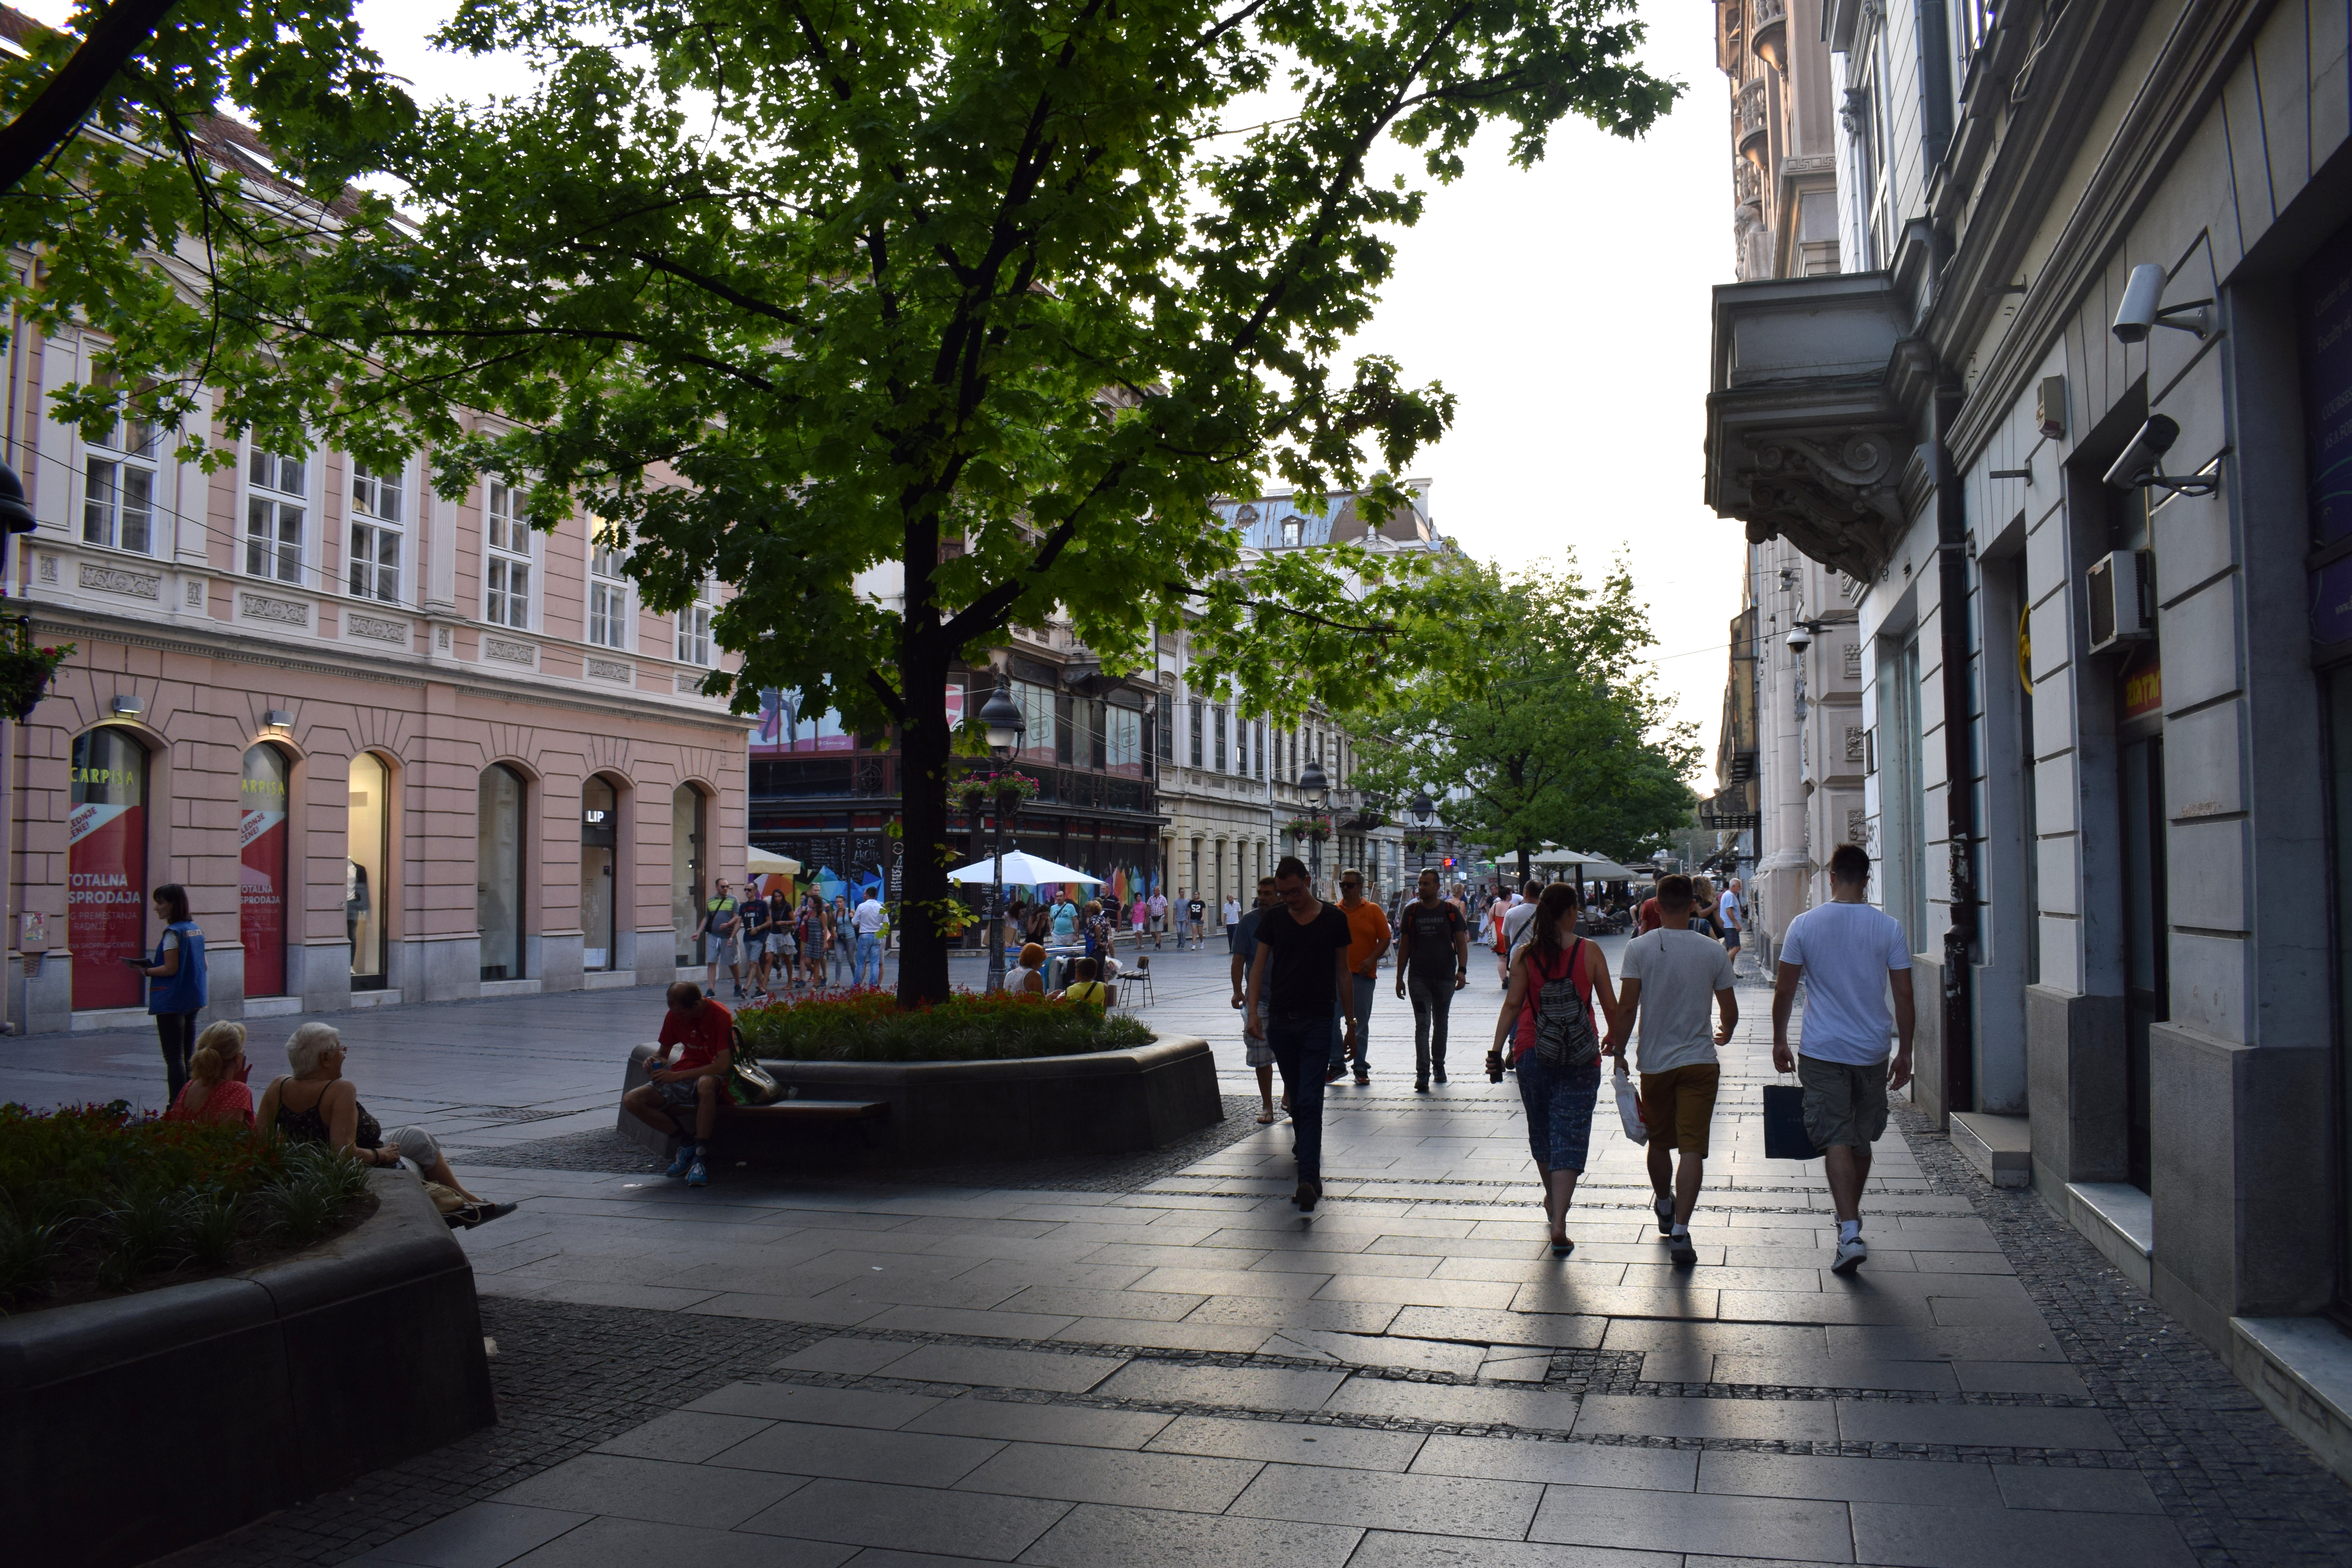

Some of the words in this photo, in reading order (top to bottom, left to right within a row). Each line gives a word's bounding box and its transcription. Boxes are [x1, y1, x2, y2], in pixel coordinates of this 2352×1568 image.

[2317, 323, 2342, 354] Faculty
[70, 767, 134, 785] CARPISA
[70, 806, 98, 829] EDNJE
[70, 821, 90, 840] ENE!
[79, 910, 137, 920] PREMEŠTANJA
[1191, 904, 1201, 913] 52
[74, 922, 107, 930] RADNJE
